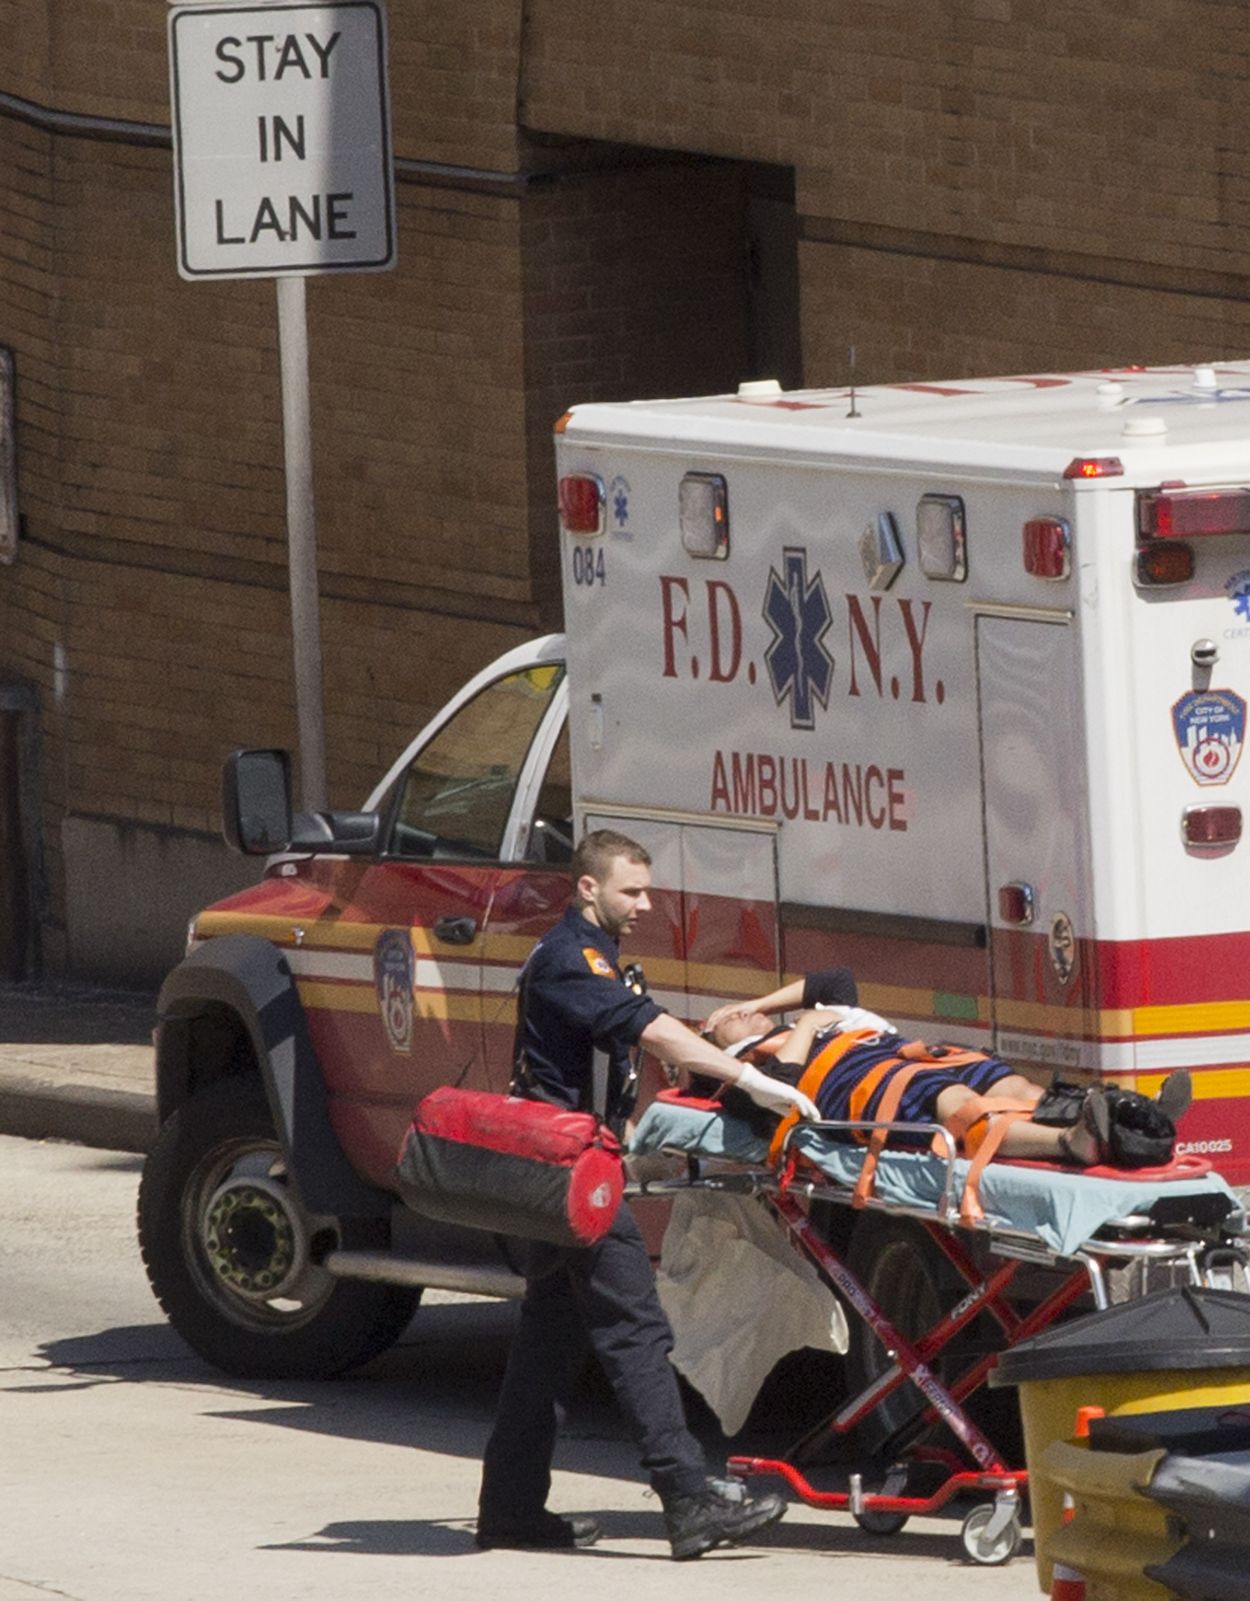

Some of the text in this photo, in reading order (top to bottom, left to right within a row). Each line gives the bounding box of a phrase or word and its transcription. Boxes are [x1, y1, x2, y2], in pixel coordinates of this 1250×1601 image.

[214, 31, 342, 84] STAY
[258, 115, 306, 162] IN
[215, 192, 357, 246] LANE
[573, 545, 607, 587] 084
[660, 575, 946, 706] F.D. N.Y.
[710, 750, 908, 831] AMBULANCE
